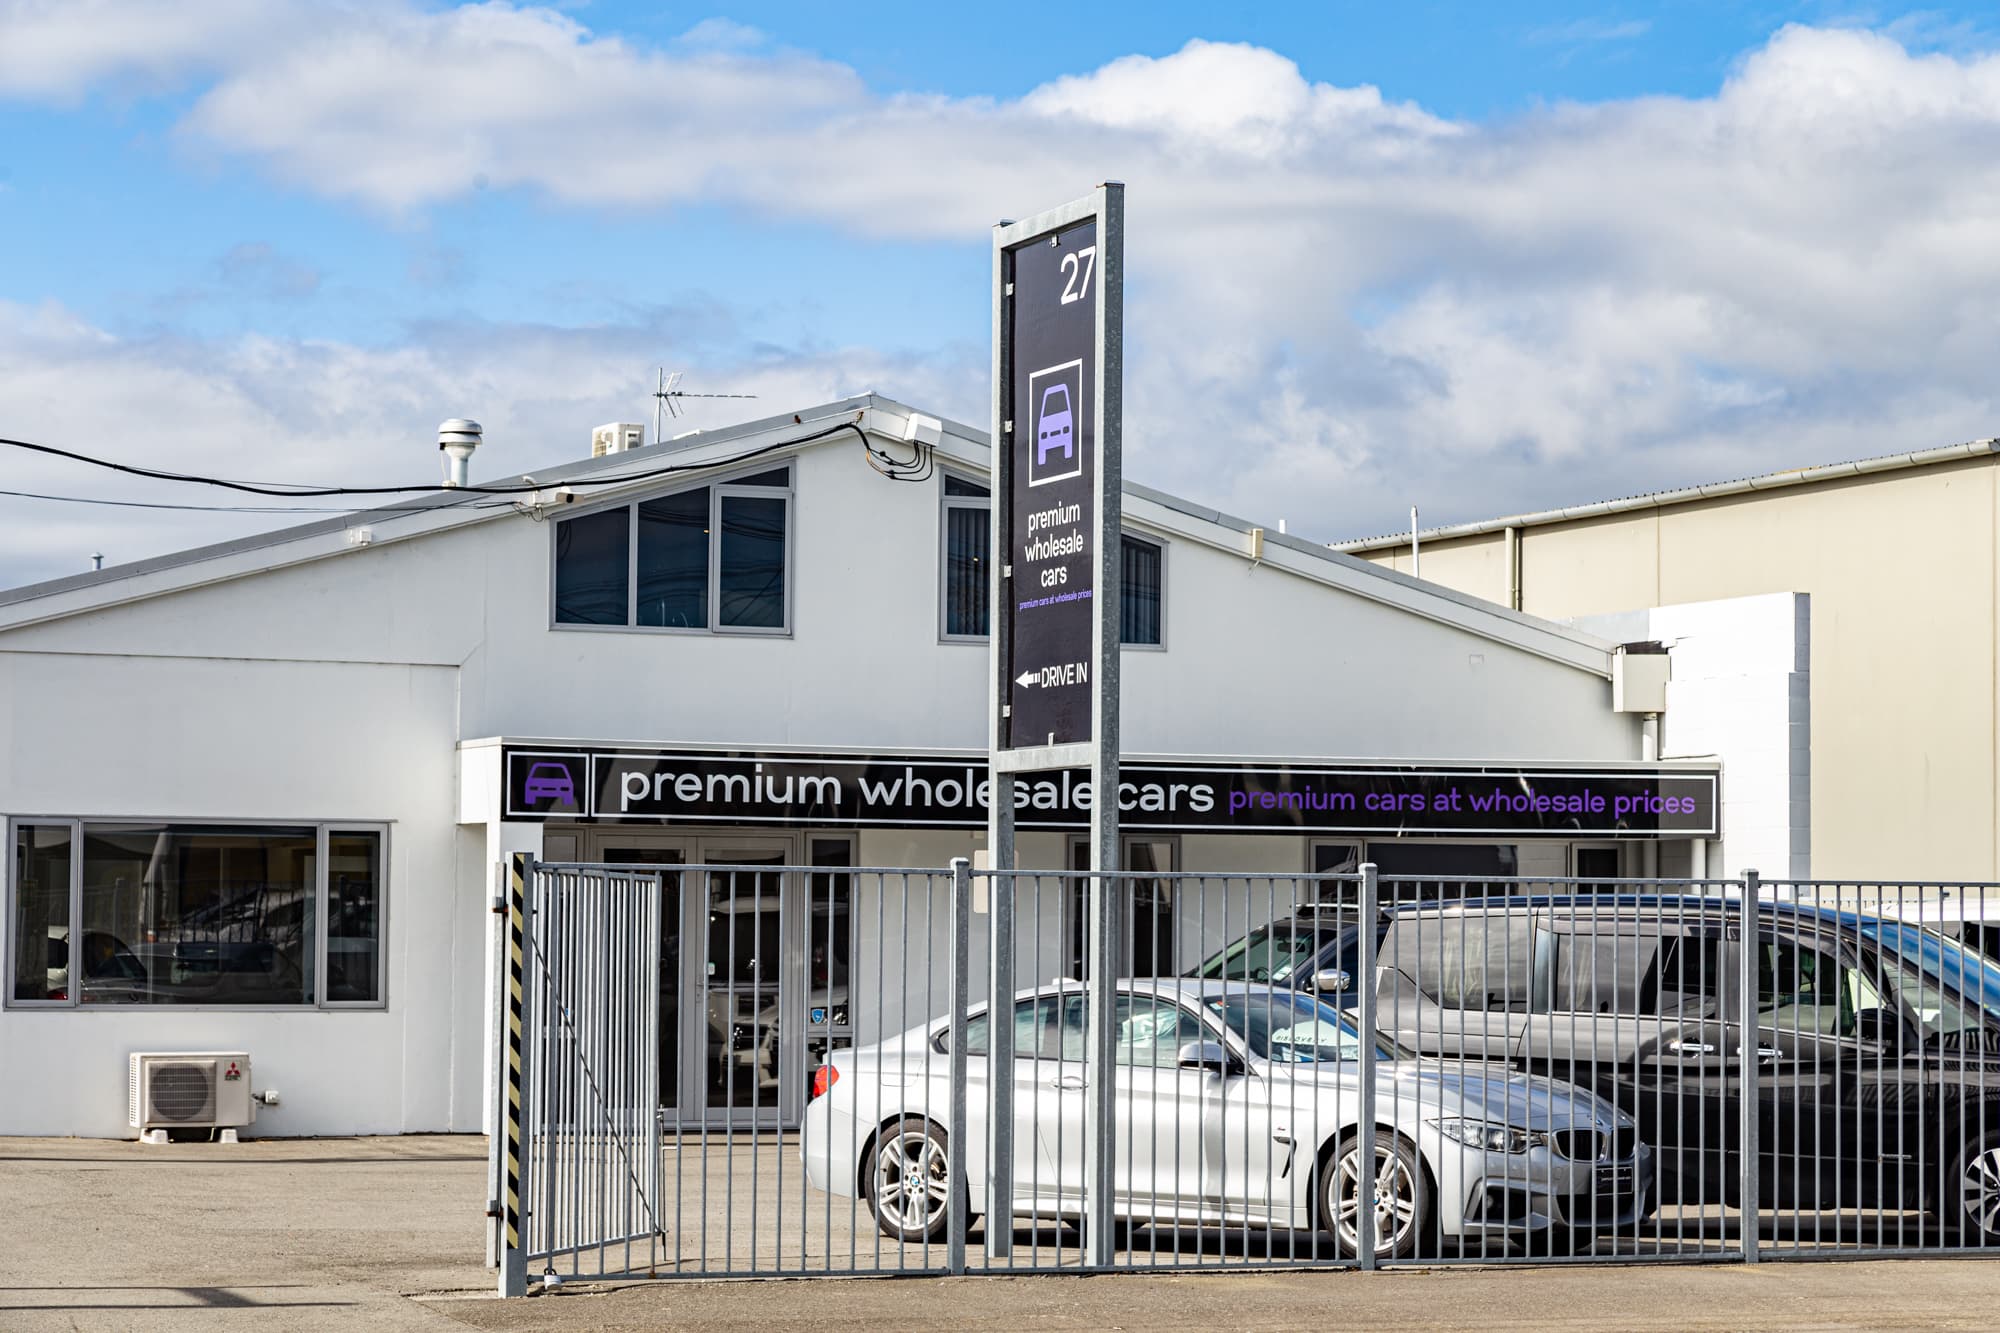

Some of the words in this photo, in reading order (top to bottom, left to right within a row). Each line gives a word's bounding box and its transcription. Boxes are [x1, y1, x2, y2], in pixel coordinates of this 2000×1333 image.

[1061, 245, 1096, 305] 27
[1028, 500, 1080, 538] premium
[1024, 528, 1084, 562] wholesale
[1041, 566, 1067, 588] cars
[1019, 598, 1038, 612] premium
[1039, 597, 1049, 606] cars
[1055, 591, 1077, 602] wholesale
[1041, 664, 1074, 688] DRIVE
[1076, 662, 1088, 683] IN
[621, 763, 842, 812] premium
[1118, 783, 1215, 812] cars
[1229, 785, 1355, 816] premium
[1364, 791, 1426, 812] cars
[1433, 787, 1462, 812] at
[1468, 787, 1606, 813] wholesale
[1614, 789, 1696, 819] prices
